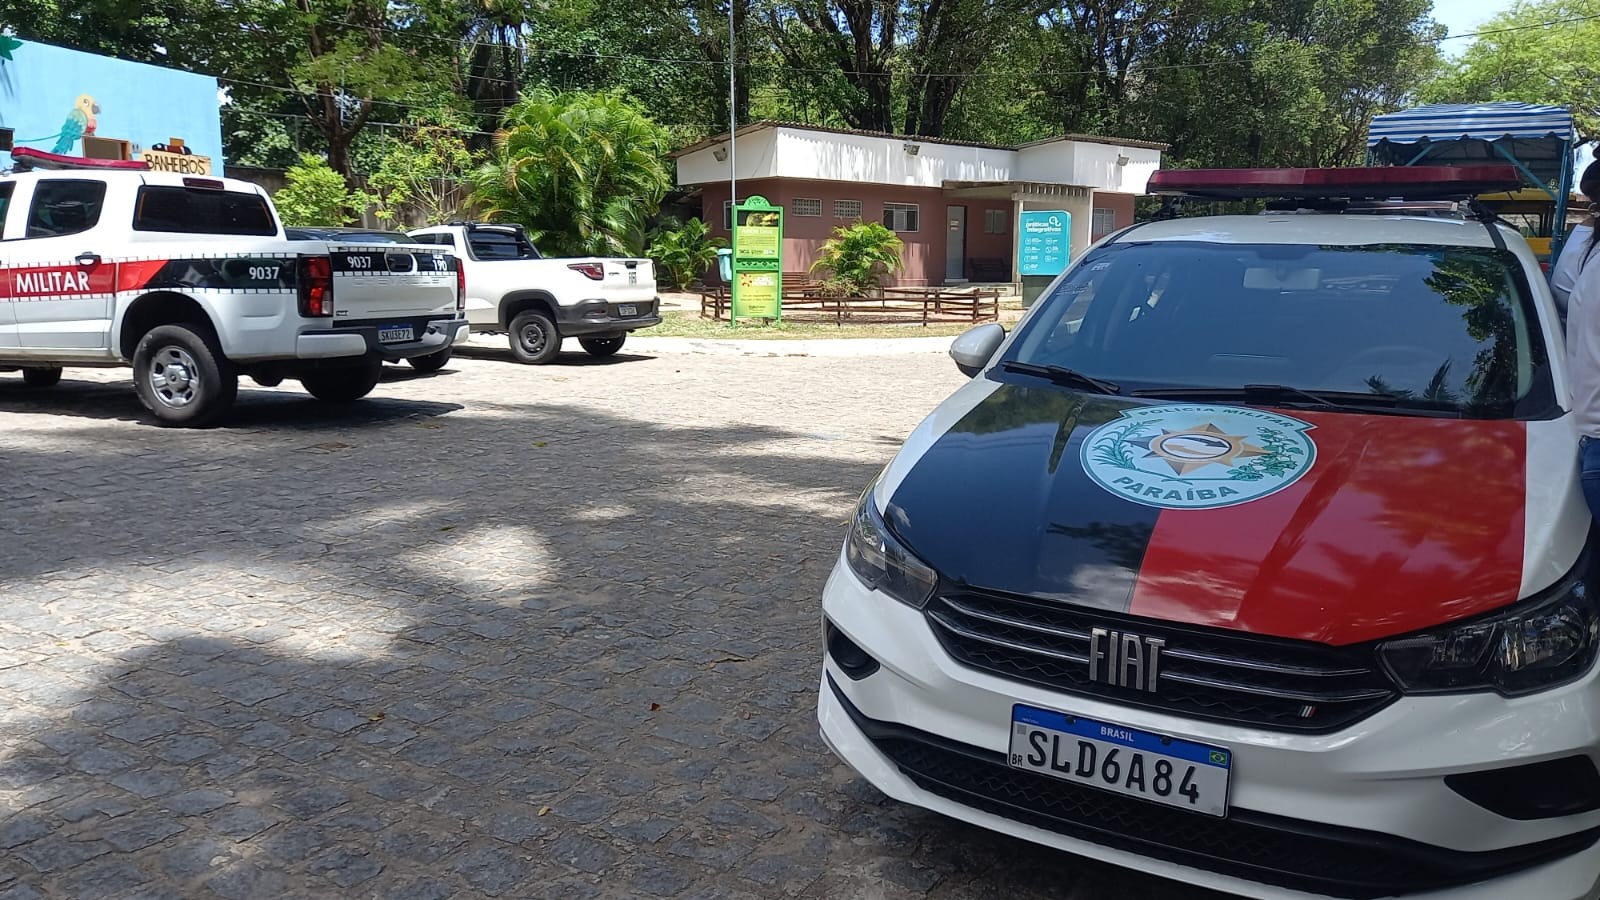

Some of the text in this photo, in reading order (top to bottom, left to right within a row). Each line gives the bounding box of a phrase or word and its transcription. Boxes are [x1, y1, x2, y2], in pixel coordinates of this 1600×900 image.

[144, 153, 205, 175] BANHEIROS
[346, 255, 371, 269] 9037
[432, 259, 448, 271] 190
[16, 271, 90, 293] MILITAR
[248, 266, 279, 280] 9037
[381, 328, 411, 342] SKU3E72
[1222, 408, 1295, 428] MILITAR
[1112, 475, 1240, 501] PARAÍBA
[1089, 627, 1166, 693] FIAT
[1100, 726, 1134, 743] BRASIL
[1011, 753, 1023, 767] BR
[1027, 729, 1200, 804] SLD6A84
